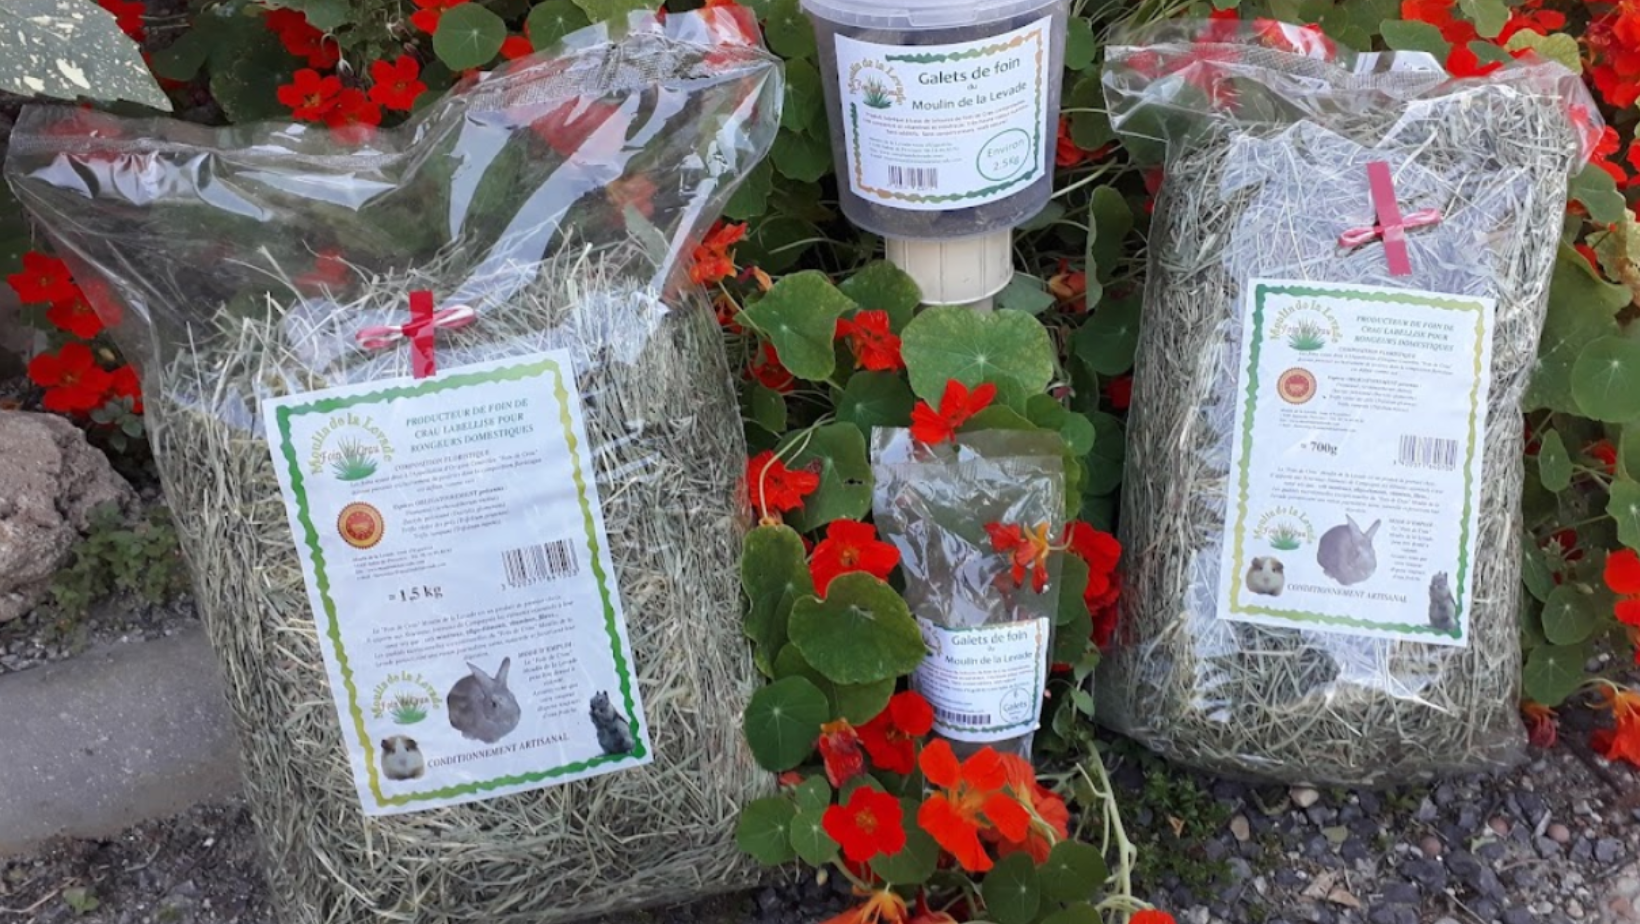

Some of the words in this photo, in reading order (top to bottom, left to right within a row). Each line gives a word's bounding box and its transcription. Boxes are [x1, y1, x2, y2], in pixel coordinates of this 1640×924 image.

[918, 70, 967, 86] Galets
[971, 66, 990, 80] de
[993, 57, 1020, 74] foin
[966, 83, 977, 91] du
[912, 100, 955, 111] Moulin
[957, 98, 973, 108] de
[976, 95, 987, 104] la
[990, 81, 1027, 100] Levade
[987, 138, 1024, 157] Environ
[1356, 315, 1409, 326] PRODUCTEUR
[1422, 321, 1442, 329] FOIN
[1361, 325, 1382, 333] CRAU
[1427, 332, 1447, 340] POUR
[1353, 335, 1396, 345] RONGEURS
[1397, 339, 1454, 352] DOMESTIQUES
[405, 409, 470, 426] PRODUCTEUR
[471, 406, 486, 415] DE
[487, 401, 513, 412] FOIN
[515, 398, 528, 407] DE
[329, 417, 345, 430] de
[414, 427, 440, 438] CRAU
[442, 417, 495, 433] LABELLISE
[497, 413, 524, 423] POUR
[409, 436, 462, 452] RONGEURS
[463, 424, 534, 444] DOMESTIQUES
[1310, 441, 1338, 456] 700g
[423, 584, 443, 598] kg
[1287, 583, 1365, 598] CONDITIONNEMENT
[1366, 591, 1407, 603] ARTISANAL
[951, 634, 988, 645] Galets
[991, 633, 1003, 643] de
[1007, 631, 1027, 640] foin
[945, 655, 978, 666] Moulin
[980, 655, 991, 665] de
[993, 655, 1001, 663] la
[1004, 651, 1033, 663] Levade
[1003, 700, 1027, 713] Galets
[427, 744, 517, 768] CONDITIONNEMENT
[519, 733, 570, 750] ARTISANAL
